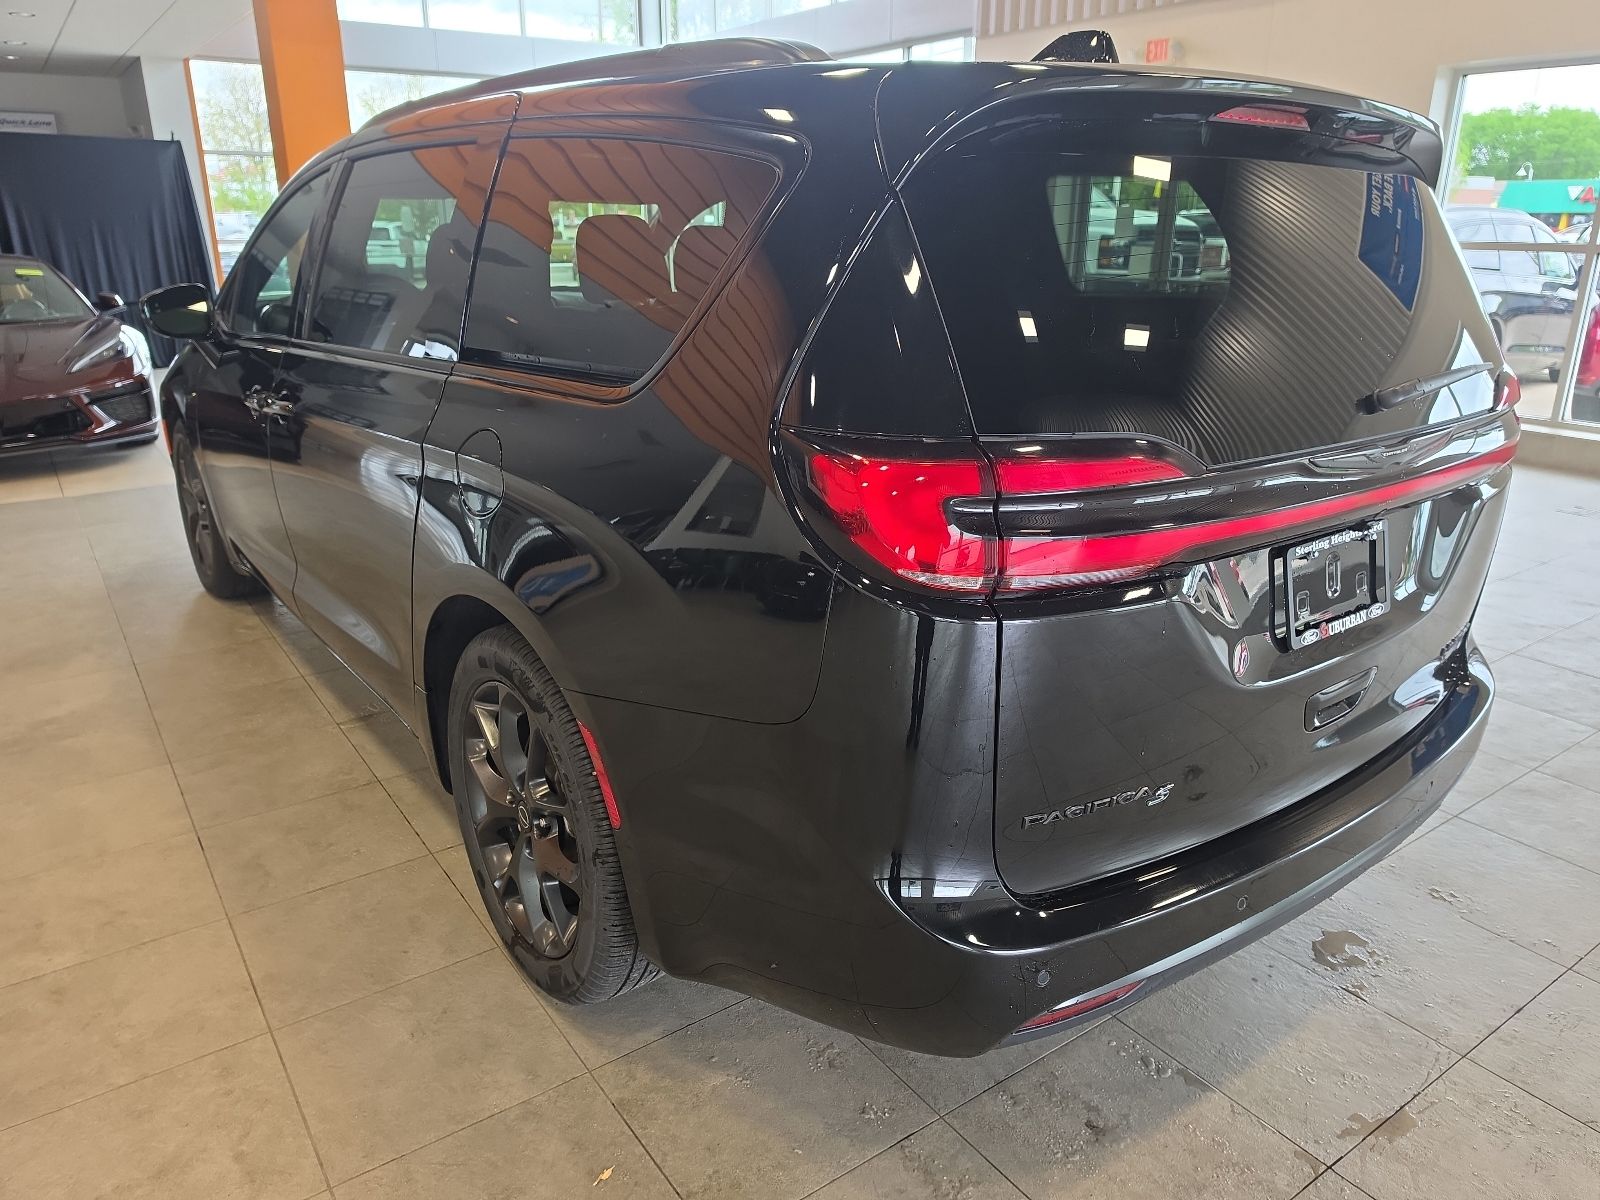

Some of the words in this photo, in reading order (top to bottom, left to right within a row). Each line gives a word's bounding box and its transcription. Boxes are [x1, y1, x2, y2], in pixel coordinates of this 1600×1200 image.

[1146, 39, 1169, 63] EXIT
[1295, 539, 1330, 557] Sterling
[1320, 609, 1367, 640] SUBURBAN
[1021, 786, 1153, 830] PACIFICA
